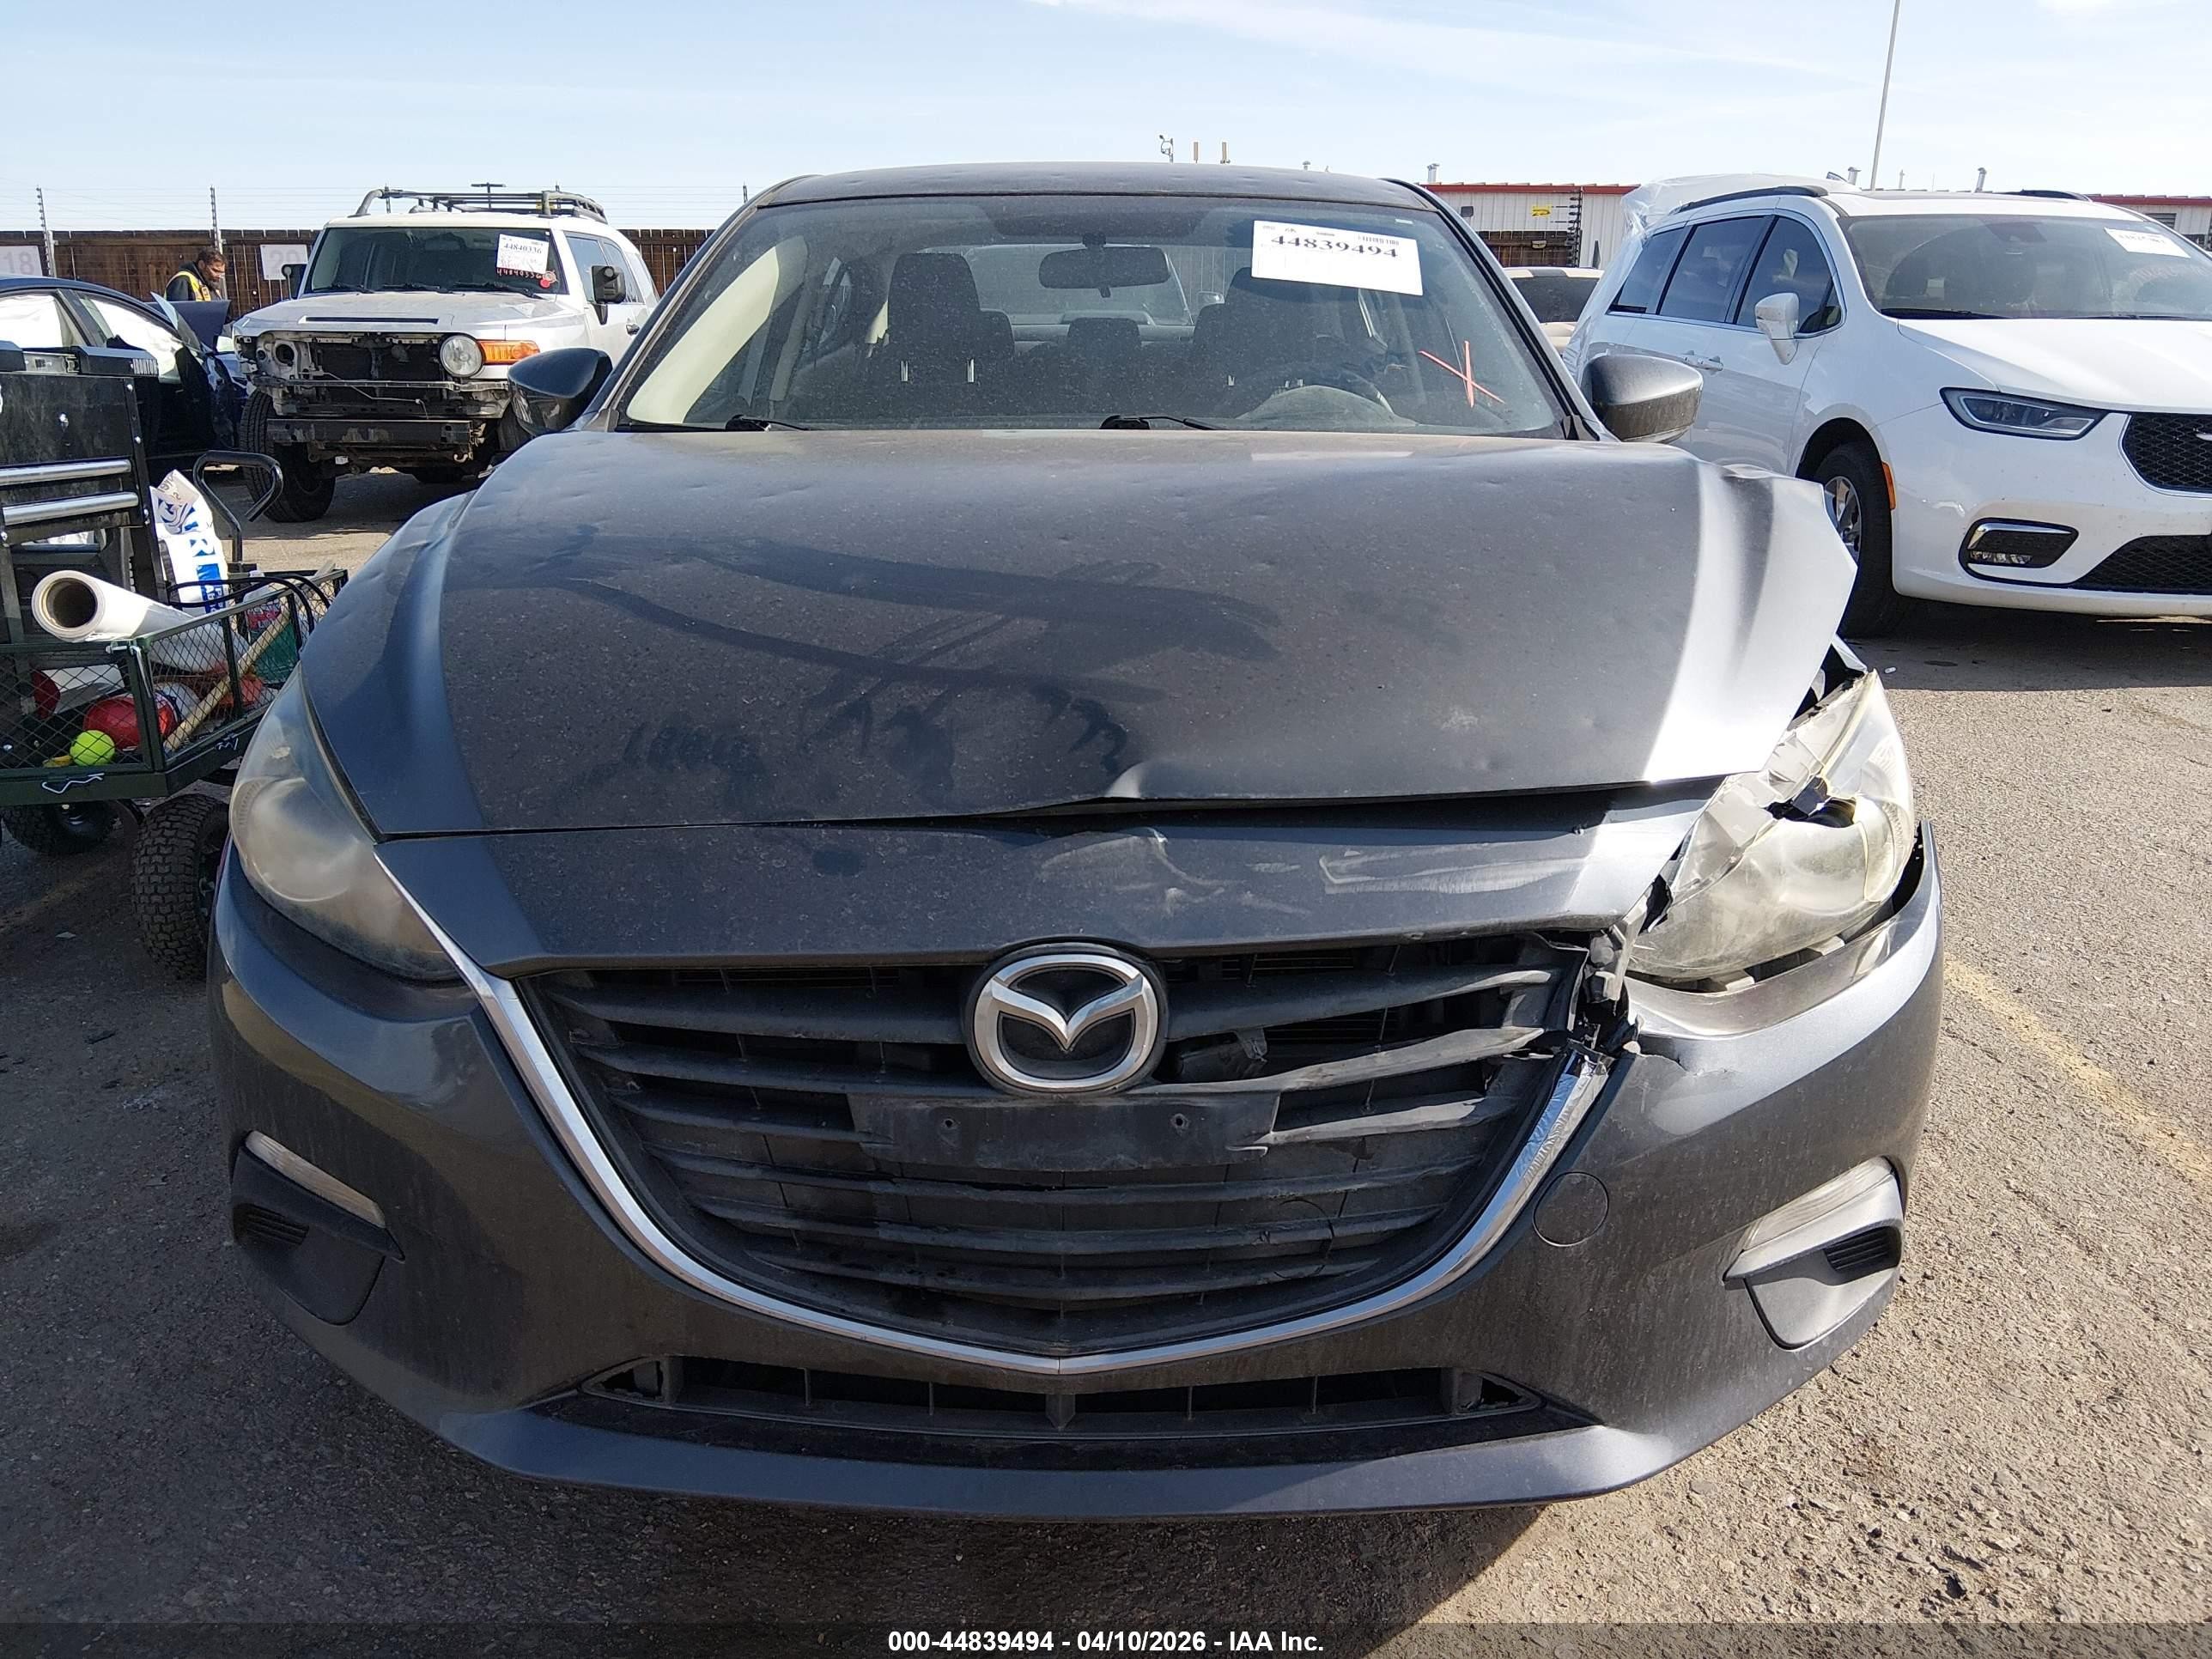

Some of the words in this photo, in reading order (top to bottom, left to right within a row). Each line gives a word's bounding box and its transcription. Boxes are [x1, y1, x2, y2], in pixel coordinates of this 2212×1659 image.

[504, 243, 542, 254] 44840336
[1271, 235, 1398, 258] 44839494
[3, 251, 34, 275] 18
